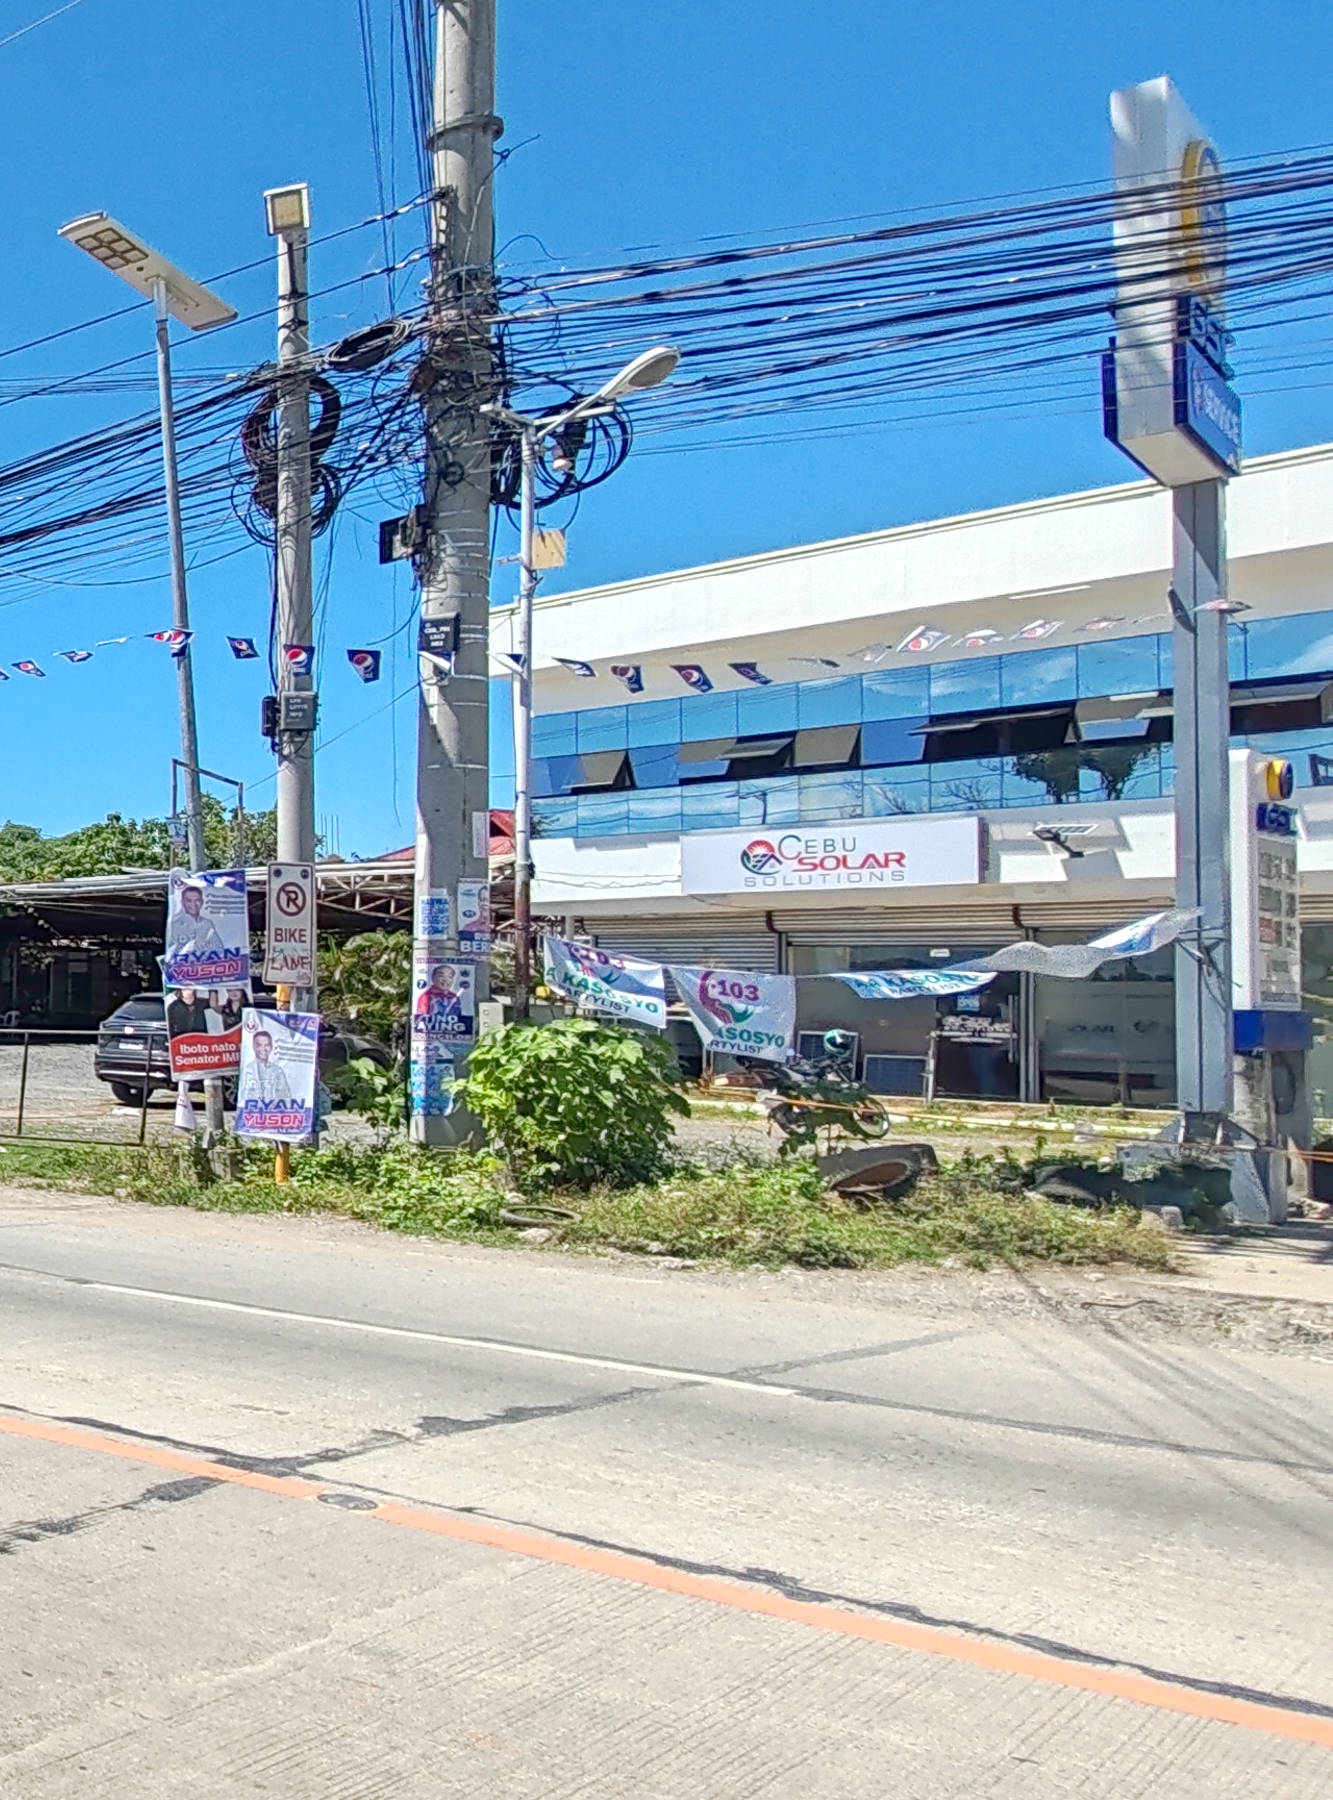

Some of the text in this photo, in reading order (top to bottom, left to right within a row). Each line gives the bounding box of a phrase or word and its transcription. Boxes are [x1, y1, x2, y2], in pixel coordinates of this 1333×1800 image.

[778, 834, 857, 860] CEBU
[791, 851, 907, 873] SOLAR
[744, 870, 906, 888] SOLUTIONS
[274, 927, 308, 943] BIKE
[174, 946, 241, 964] RYAN
[270, 955, 311, 972] LANE
[172, 960, 241, 979] YUSON
[563, 971, 659, 1014] KASOSYO
[717, 979, 760, 1002] 103
[179, 1043, 236, 1054] Iboto nato
[175, 1055, 220, 1066] Senator
[244, 1098, 306, 1111] RYAN
[244, 1113, 305, 1127] YUSON
